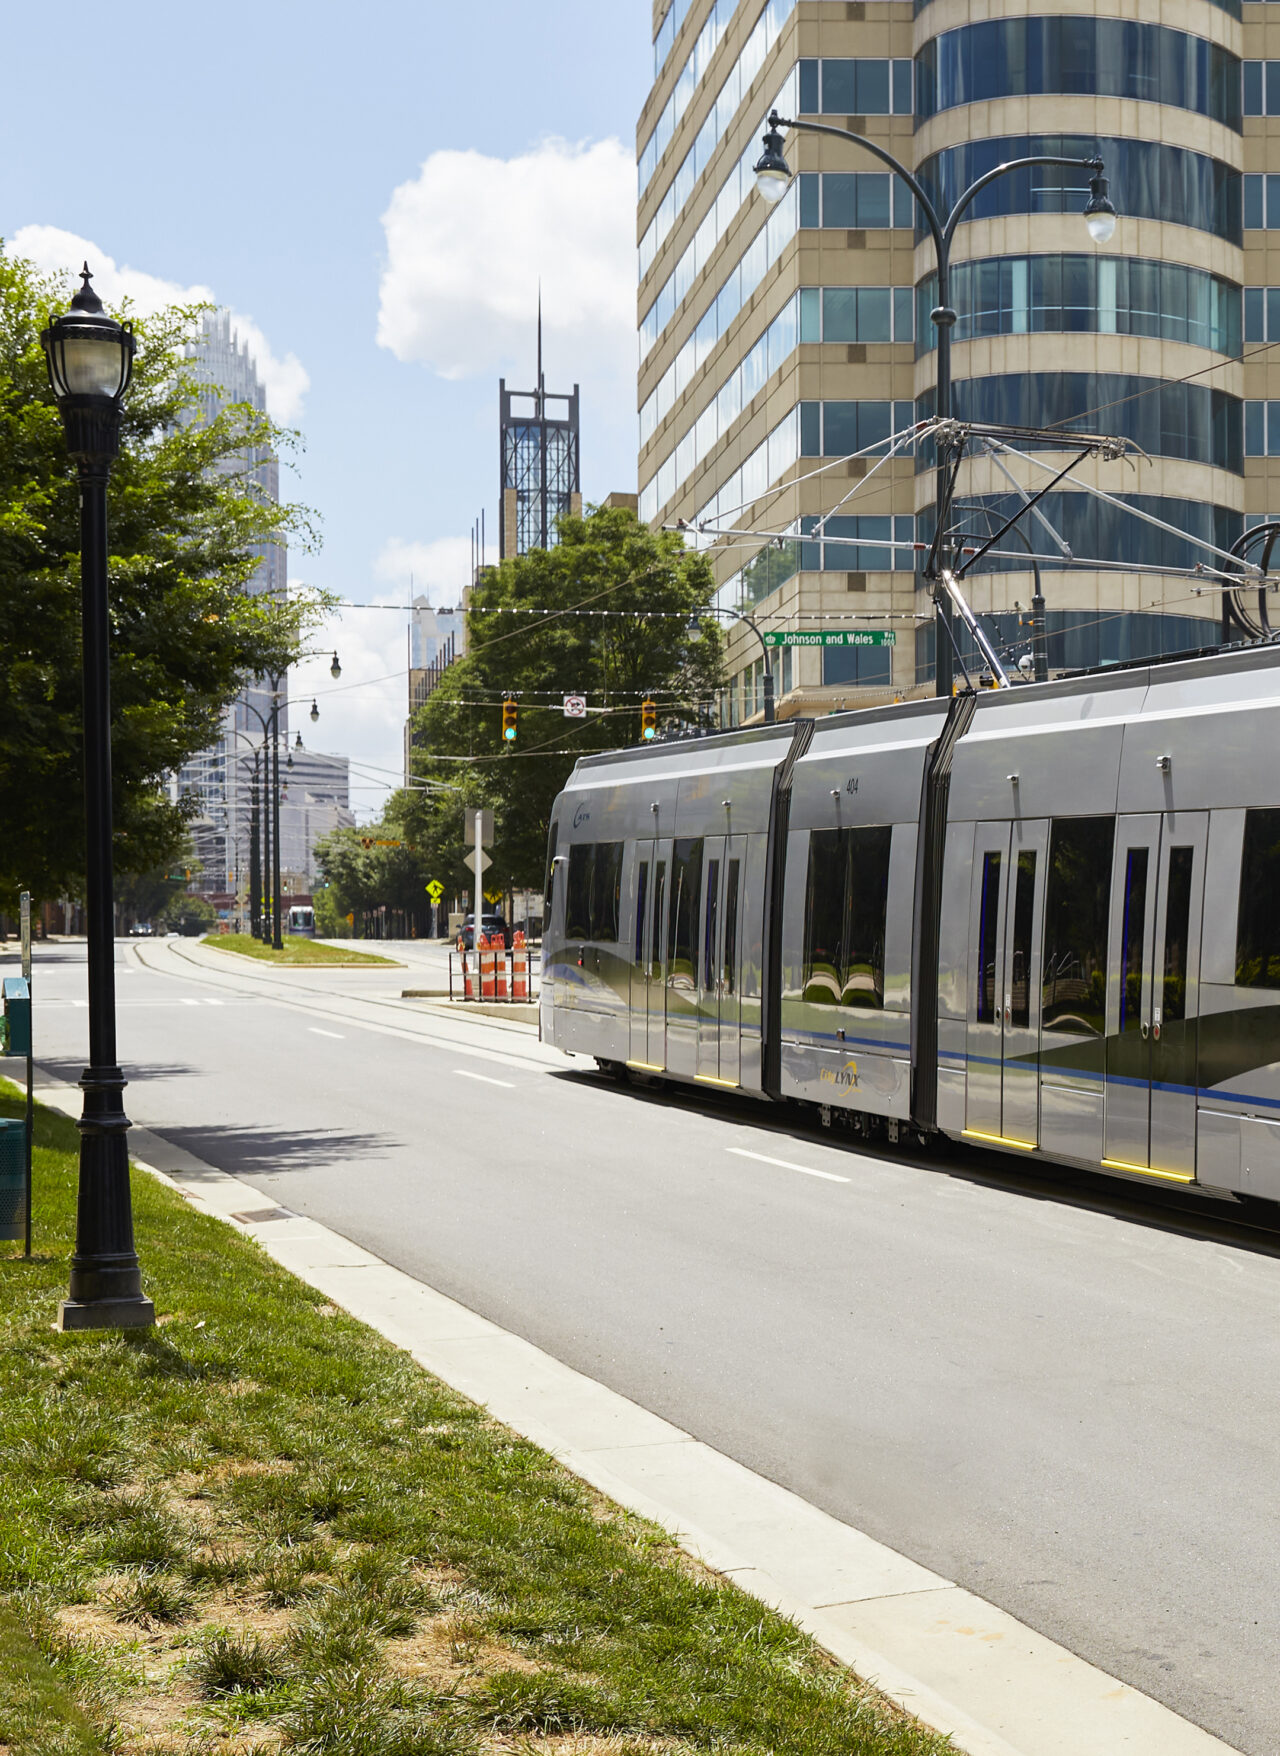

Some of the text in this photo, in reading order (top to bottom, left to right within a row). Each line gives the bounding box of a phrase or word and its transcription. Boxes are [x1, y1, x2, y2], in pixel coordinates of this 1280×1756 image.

[781, 633, 874, 645] Johnson and Wales
[846, 777, 859, 795] 404
